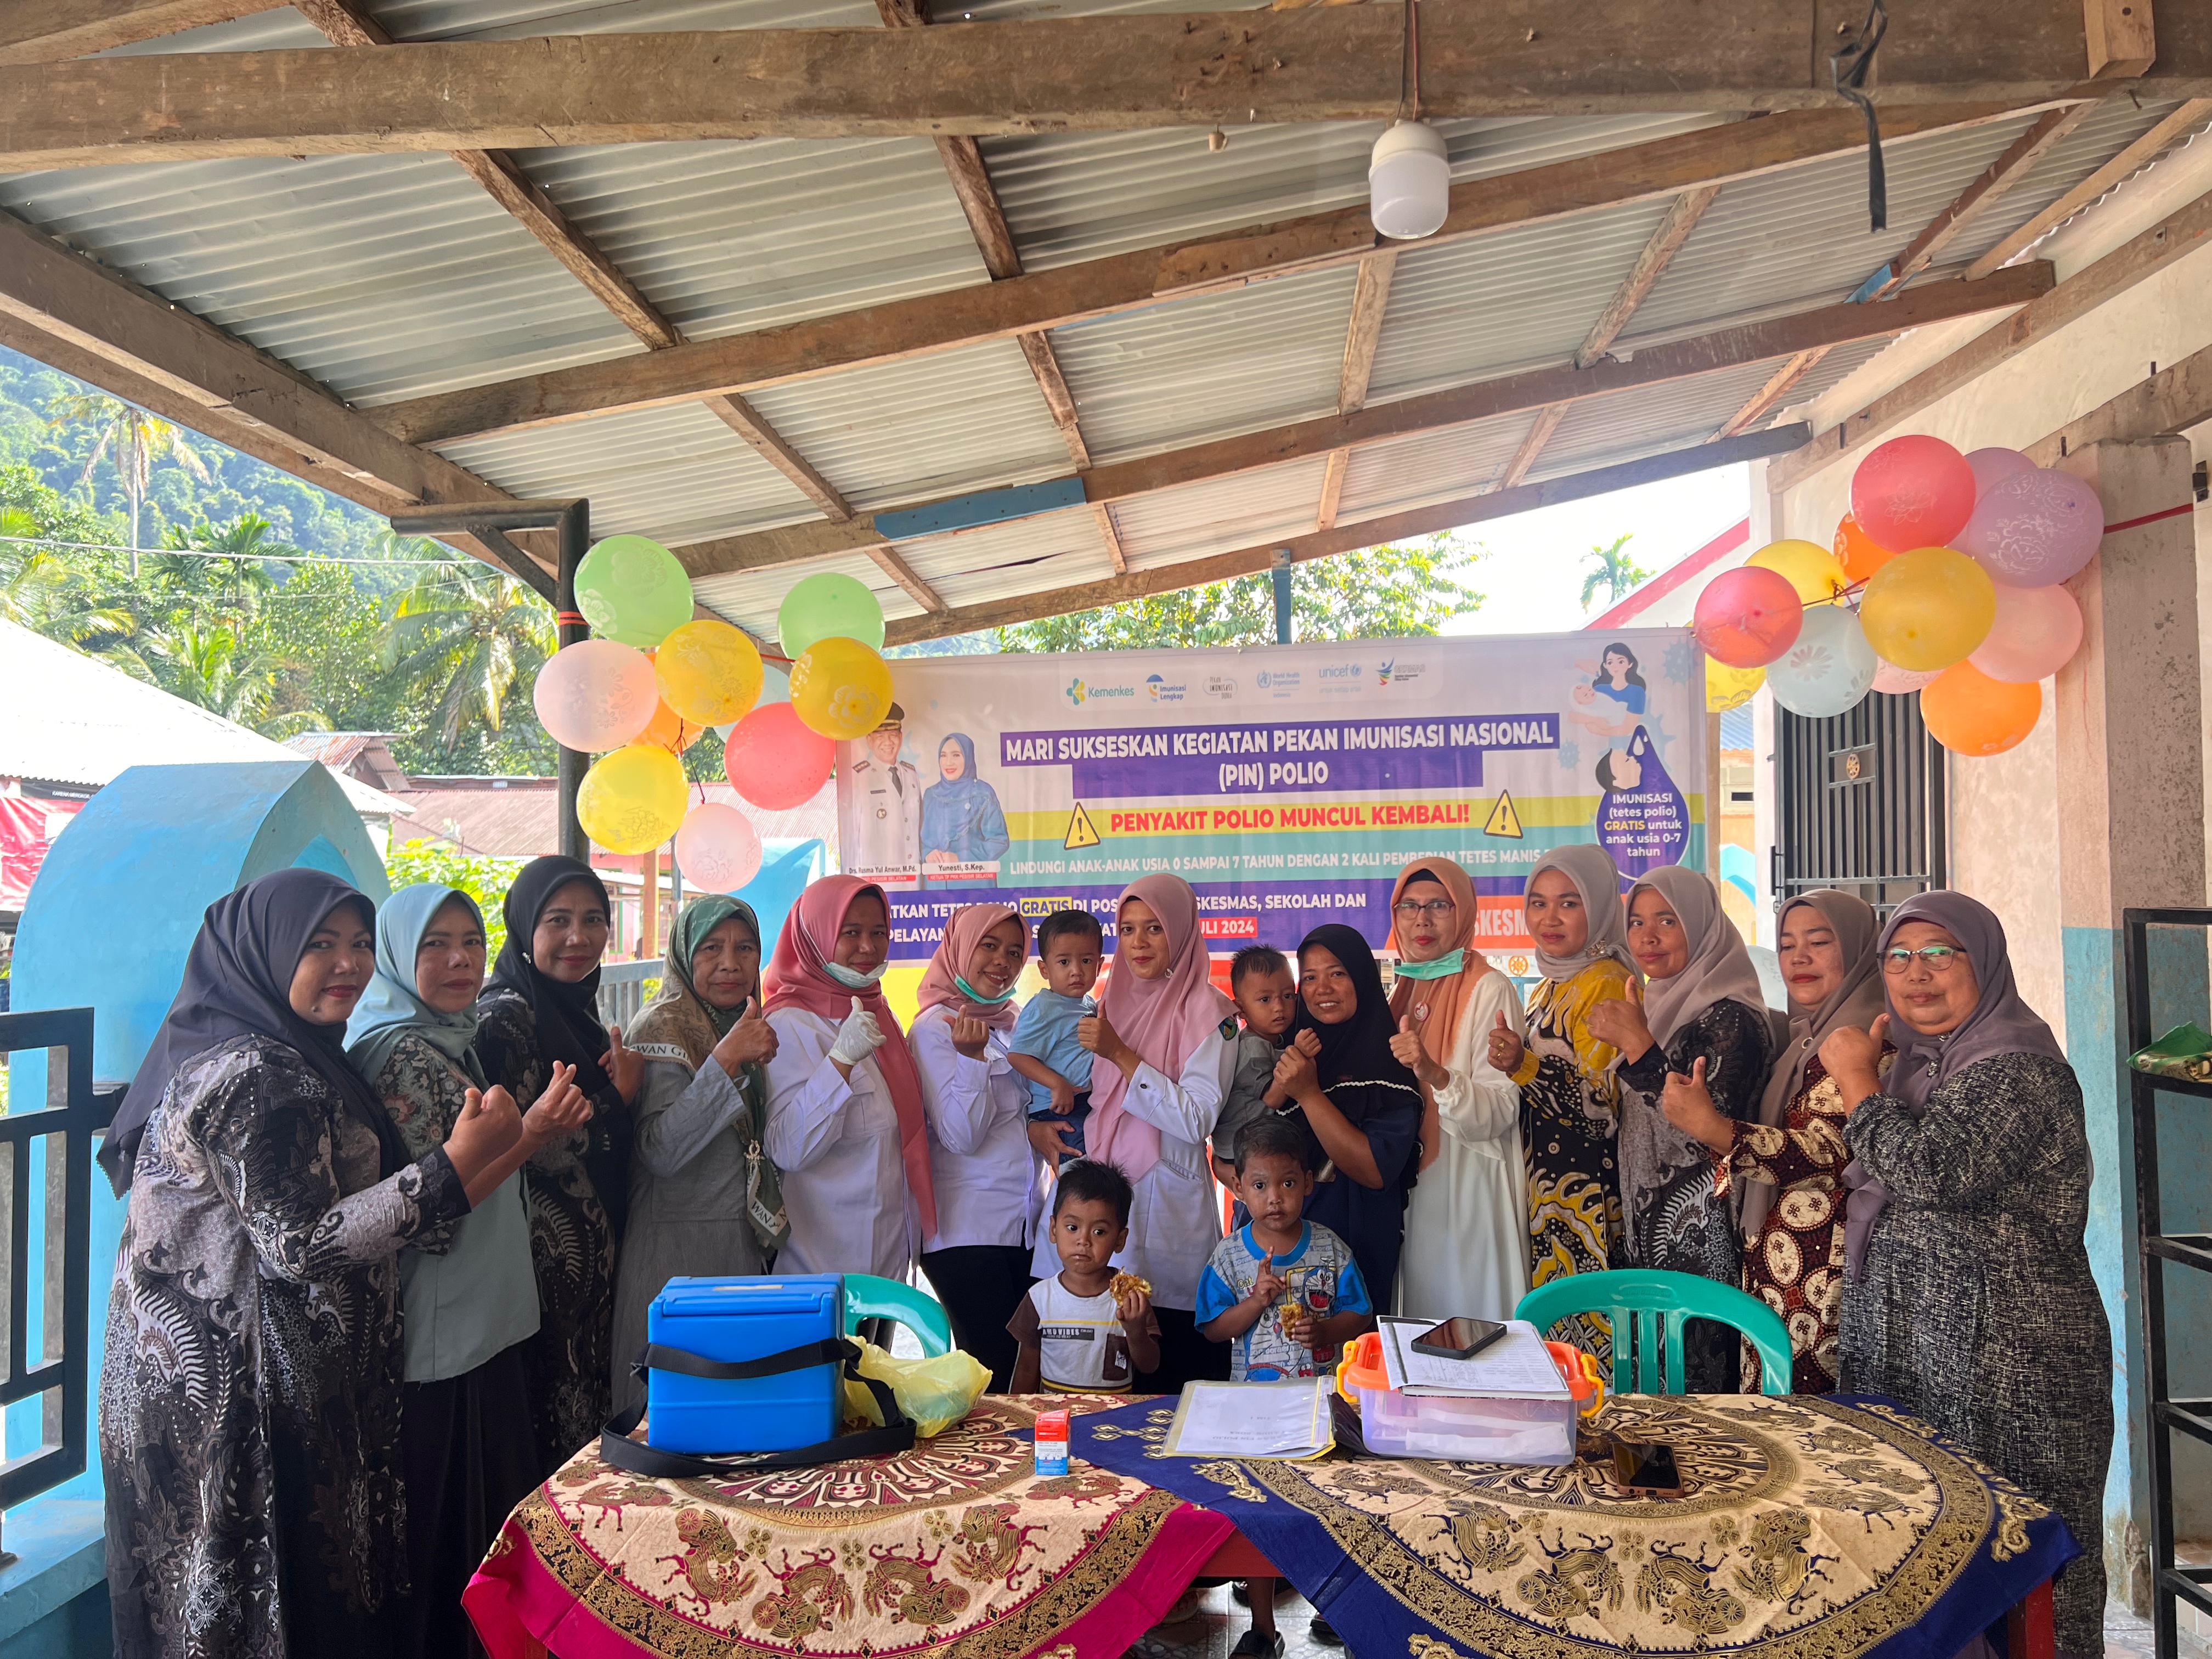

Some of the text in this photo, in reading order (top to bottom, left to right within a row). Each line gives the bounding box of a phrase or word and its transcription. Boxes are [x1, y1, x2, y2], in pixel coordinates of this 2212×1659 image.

[1319, 664, 1349, 679] unicef
[1088, 685, 1135, 698] Kemenkes
[1210, 684, 1233, 692] IMUNISASI
[1160, 693, 1183, 701] Lengkap
[1006, 721, 1554, 761] MARI SUKSESKAN KEGIATAN PEKAN IMUNISASI NASIONAL
[1219, 761, 1329, 792] (PIN) POLIO
[1612, 793, 1672, 804] IMUNISASI
[1111, 804, 1470, 832] PENYAKIT POLIO MUNCUL KEMBALI!
[1609, 805, 1677, 819] (tetes polio)
[1604, 820, 1682, 831] GRATIS untuk
[1606, 833, 1681, 844] anak usia 0-7
[1627, 847, 1660, 856] tahun
[1010, 860, 1065, 874] LINDUNGI
[1069, 858, 1139, 873] ANAK-ANAK
[1142, 857, 1168, 871] USIA
[1173, 857, 1180, 870] 0
[1183, 856, 1229, 870] SAMPAI
[1232, 856, 1239, 868] 7
[1243, 855, 1284, 868] TAHUN
[1287, 853, 1339, 867] DENGAN
[1341, 853, 1348, 866] 2
[1352, 853, 1380, 866] KALI
[1459, 850, 1497, 864] TETES
[1500, 849, 1541, 863] MANIS
[884, 866, 902, 874] Anwar,
[932, 902, 972, 917] TET
[1022, 900, 1069, 914] GRATIS
[1073, 900, 1087, 912] DI
[1091, 899, 1118, 913] POS
[1196, 895, 1262, 912] SKESMAS,
[1265, 894, 1331, 909] SEKOLAH
[1335, 893, 1366, 907] DAN
[889, 928, 945, 943] PELAYAN
[1221, 919, 1255, 934] 2024
